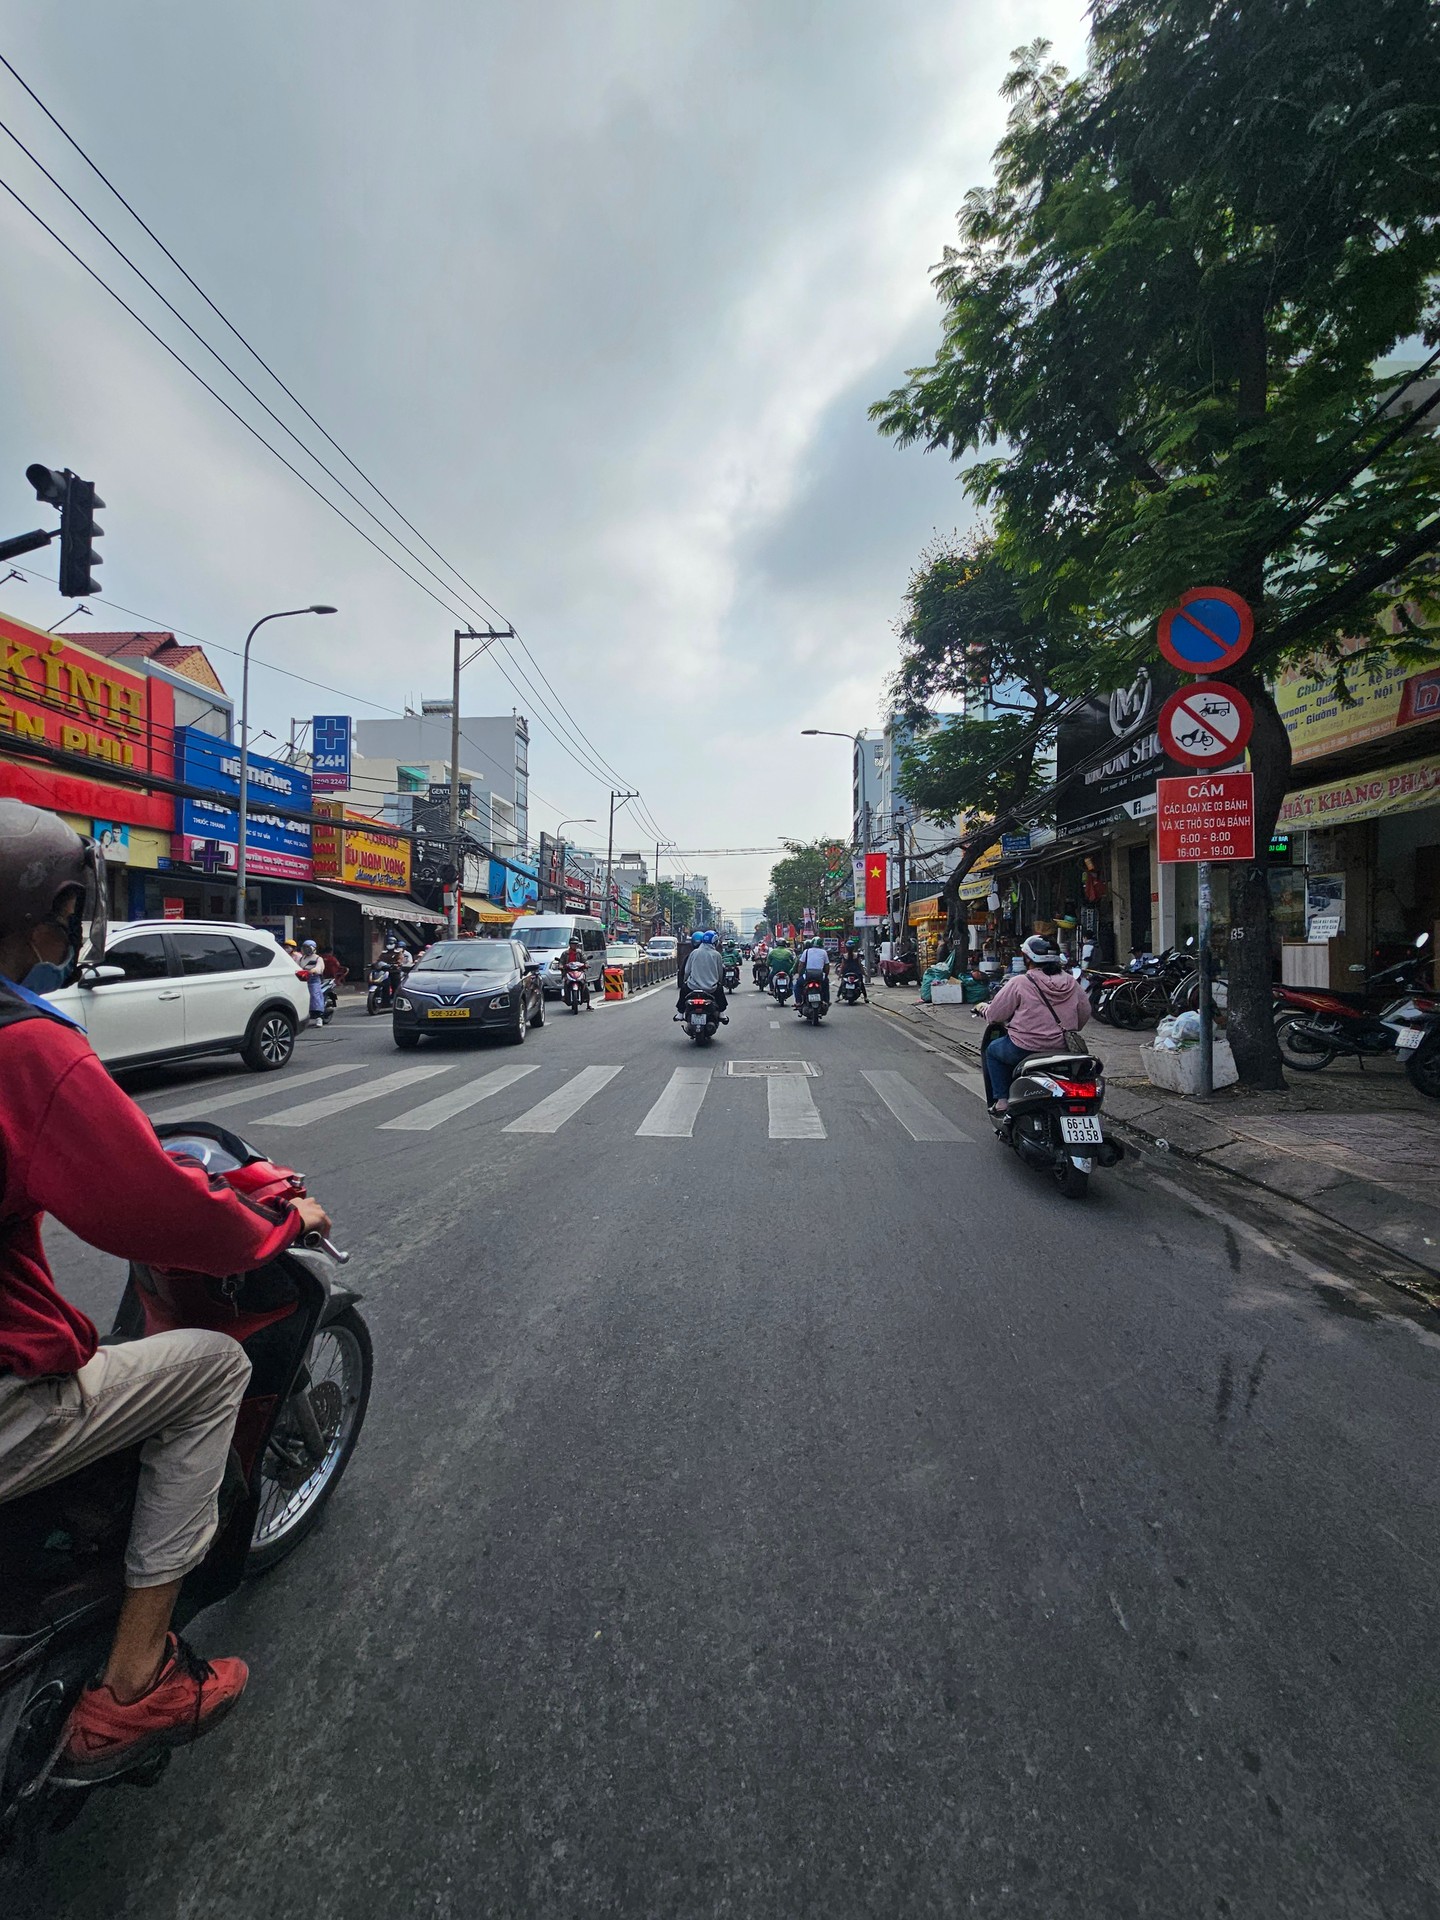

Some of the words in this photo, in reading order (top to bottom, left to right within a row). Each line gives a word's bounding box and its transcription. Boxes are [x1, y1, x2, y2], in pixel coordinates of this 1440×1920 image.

[316, 755, 345, 767] 24H
[1188, 779, 1224, 798] CẤM
[1164, 802, 1180, 814] CÁC
[1182, 802, 1200, 815] LOẠI
[1202, 802, 1212, 812] XE
[1214, 801, 1222, 811] 03
[1225, 798, 1248, 811] BÁNH
[1161, 818, 1173, 830] VÀ
[1174, 820, 1185, 830] XE
[1186, 816, 1202, 829] THÔ
[1203, 817, 1215, 828] SƠ
[1216, 817, 1226, 828] 04
[1227, 814, 1251, 827] BÁNH
[1180, 833, 1200, 844] 6:00
[1210, 832, 1230, 842] 8:00
[1177, 847, 1200, 858] 16:00
[1210, 845, 1234, 856] 19:00
[359, 850, 382, 870] NAM
[383, 856, 406, 876] VANG
[1067, 1118, 1094, 1129] 66-LA
[1067, 1130, 1099, 1142] 133.58
